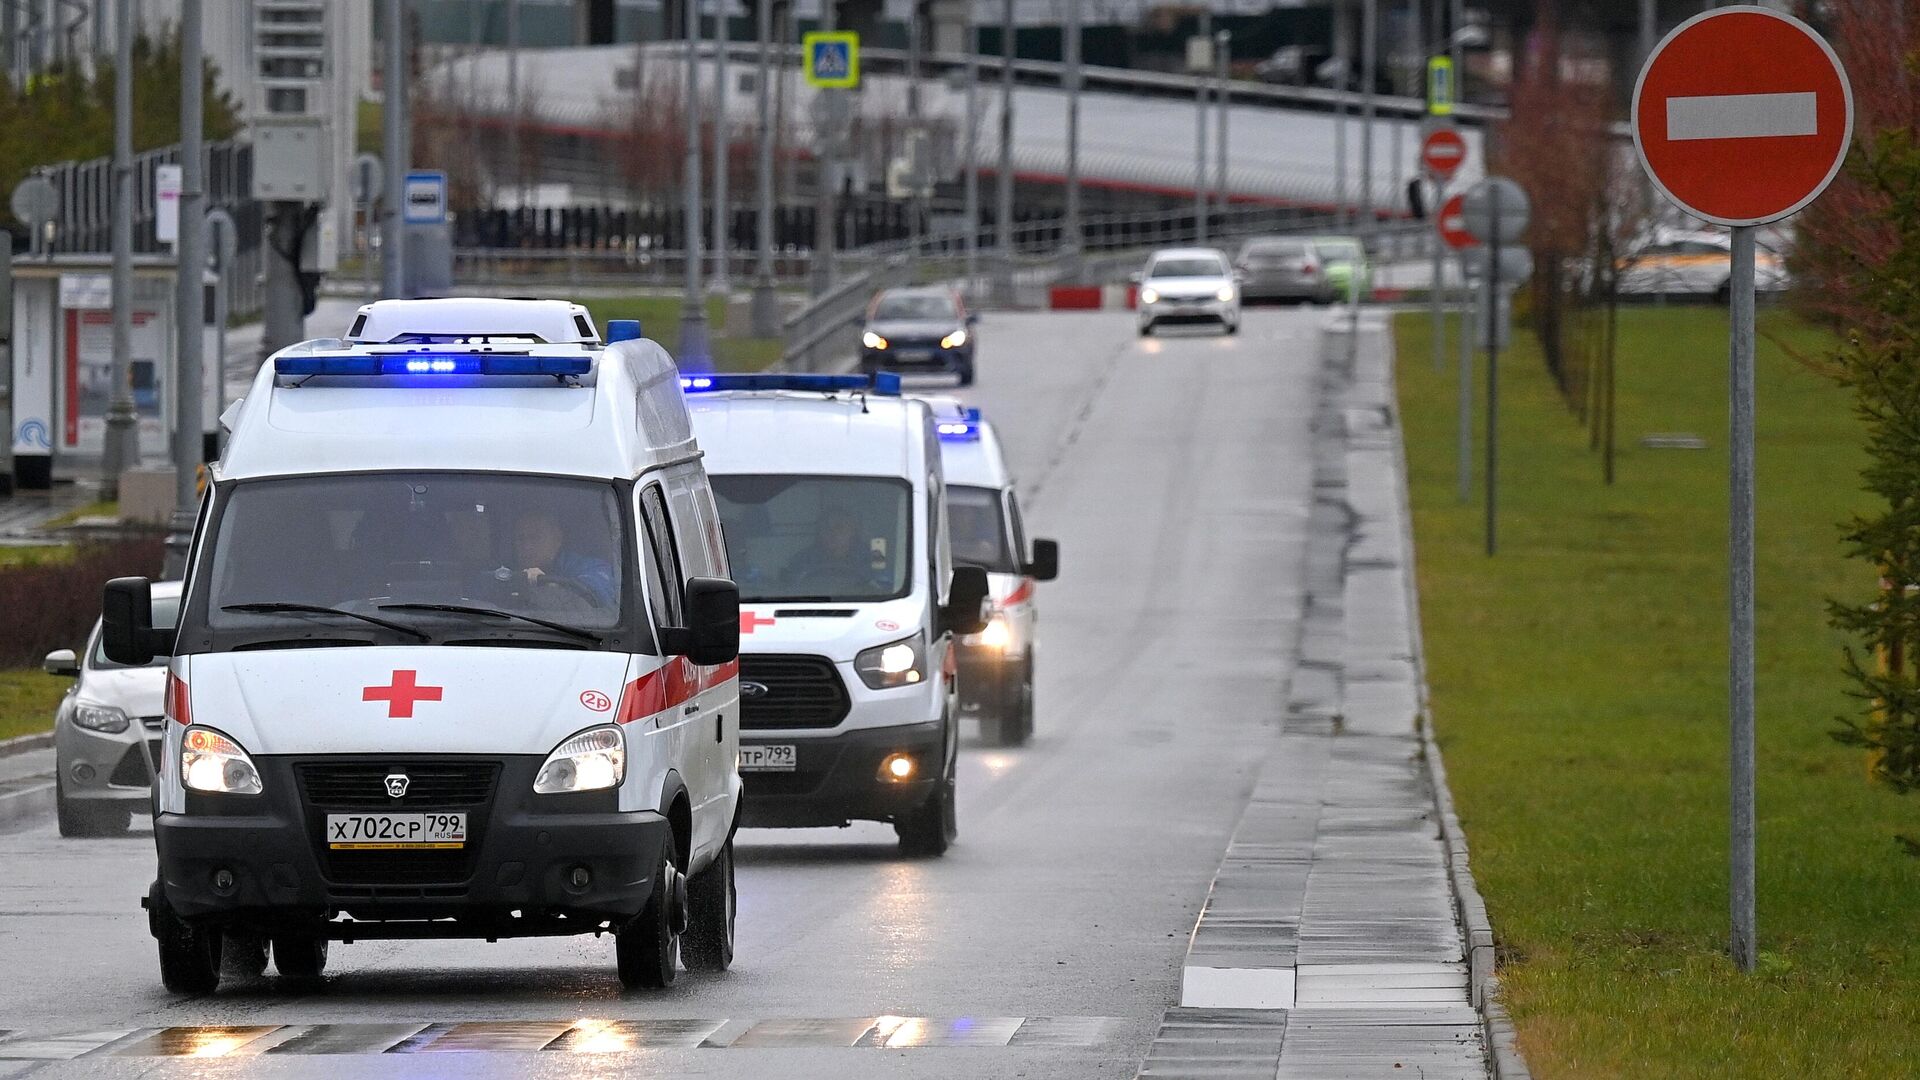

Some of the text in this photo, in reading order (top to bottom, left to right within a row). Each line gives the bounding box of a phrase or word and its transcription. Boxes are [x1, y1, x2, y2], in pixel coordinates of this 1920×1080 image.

[766, 746, 791, 760] 799
[334, 815, 460, 839] Х702СР 799
